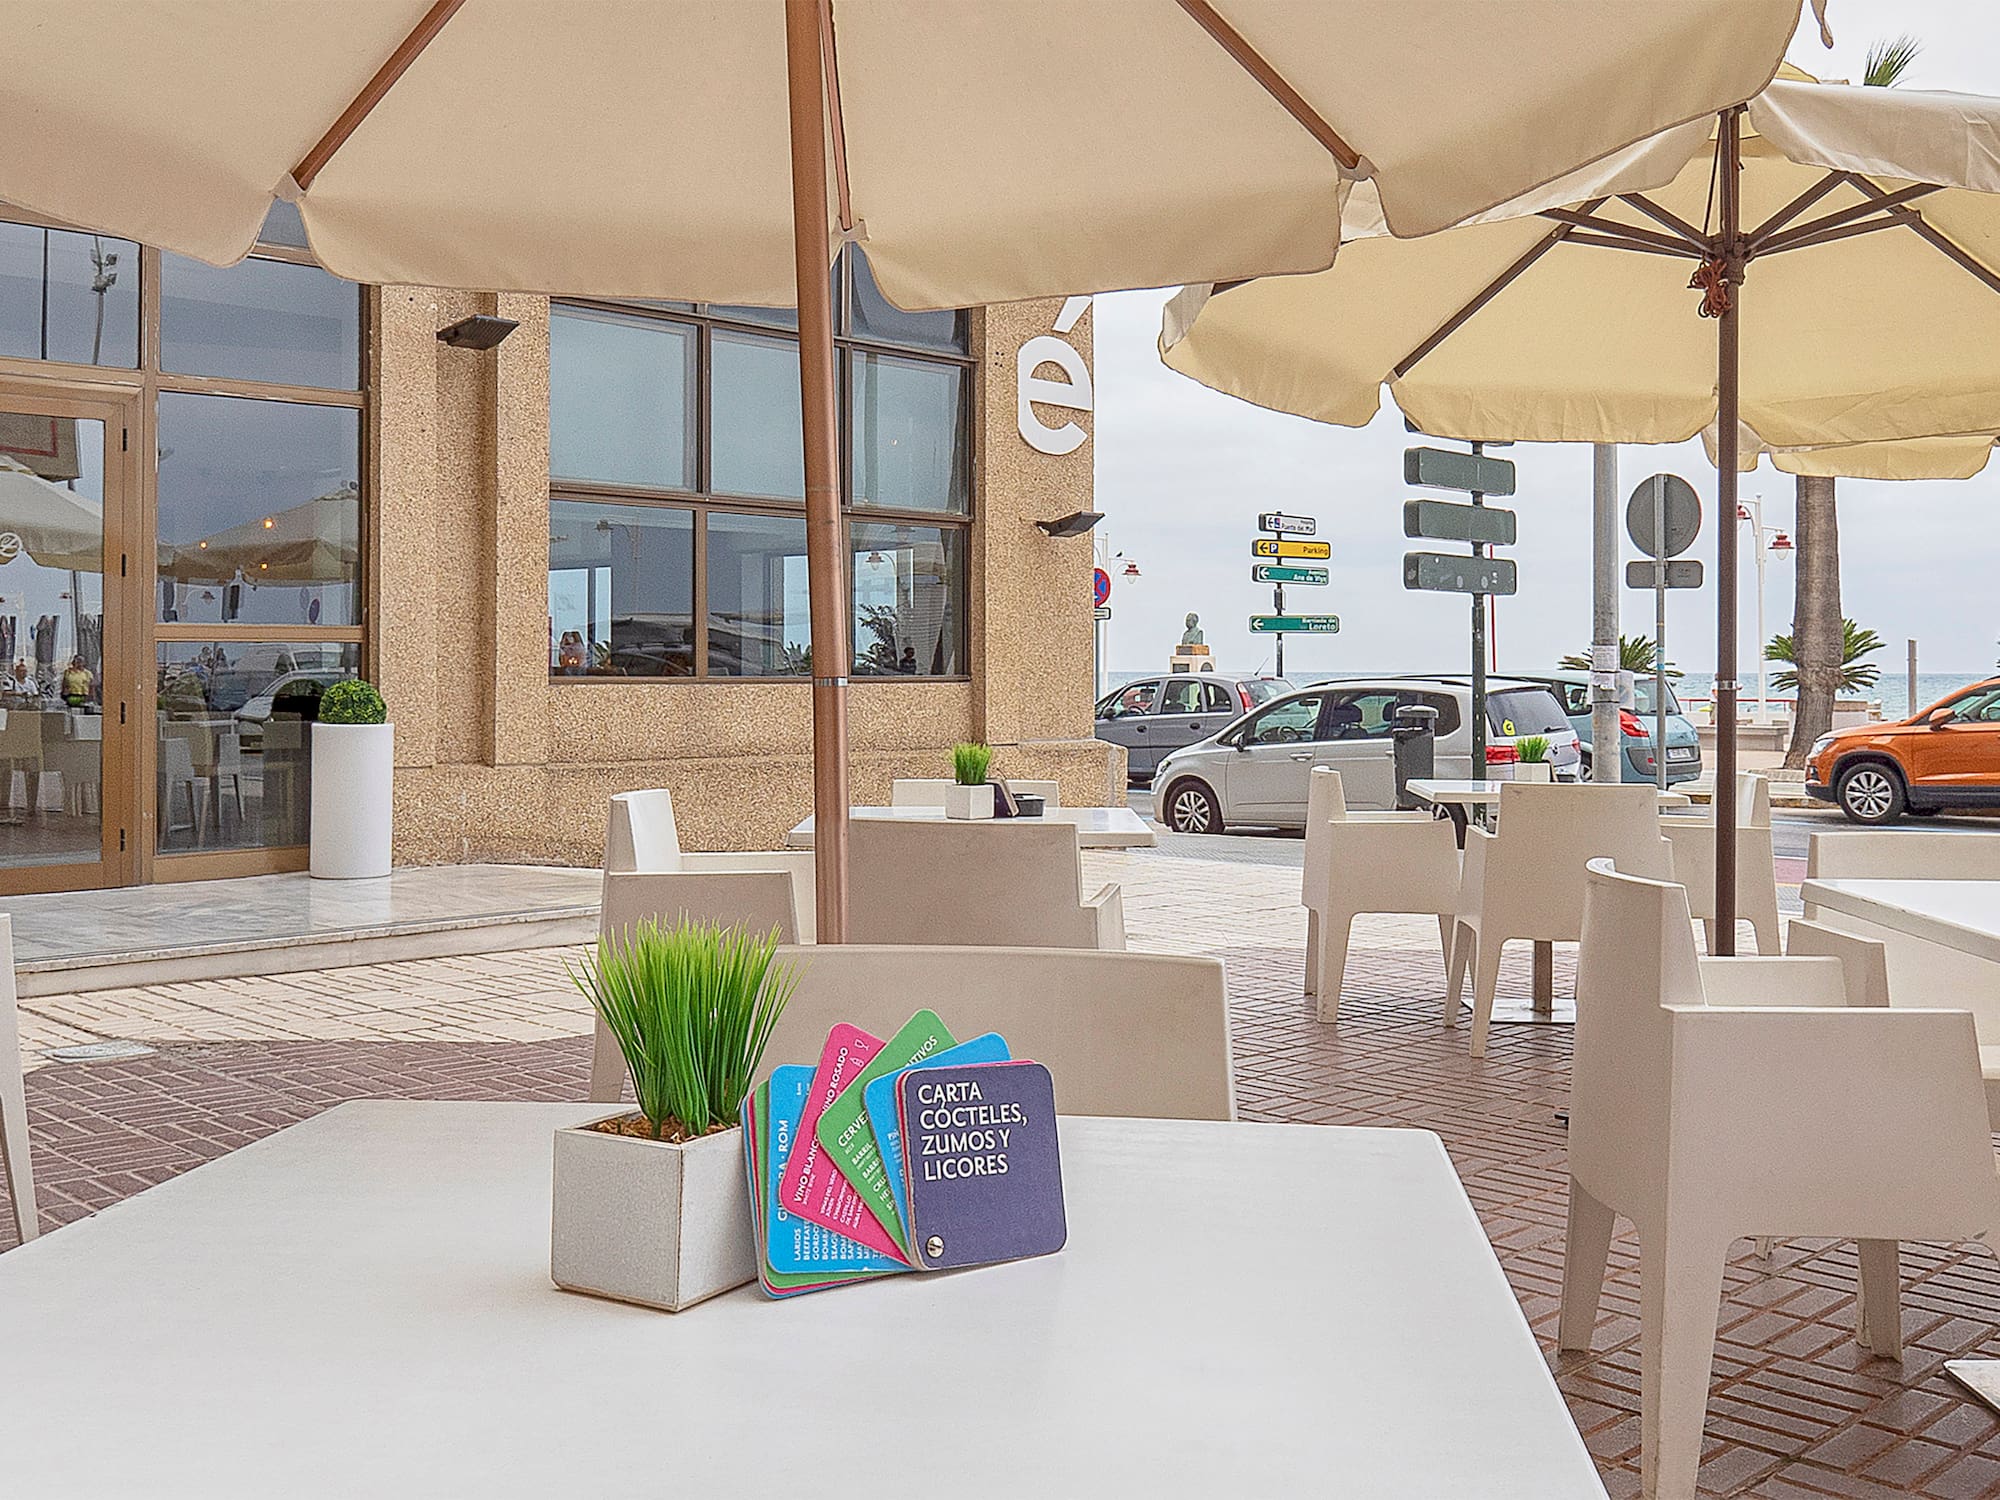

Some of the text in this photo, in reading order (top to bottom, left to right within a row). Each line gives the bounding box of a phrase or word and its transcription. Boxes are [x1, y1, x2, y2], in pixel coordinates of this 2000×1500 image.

[1302, 546, 1329, 556] Parking
[1308, 622, 1336, 630] Loreto
[905, 1035, 938, 1067] ITIVOS
[917, 1081, 983, 1105] CARTA
[793, 1175, 809, 1202] VINO
[830, 1046, 849, 1089] ROSADO
[919, 1101, 1028, 1130] CÓCTELES,
[778, 1119, 789, 1153] ROM
[921, 1131, 996, 1156] ZUMOS
[998, 1128, 1012, 1148] Y
[923, 1153, 1009, 1181] LICORES
